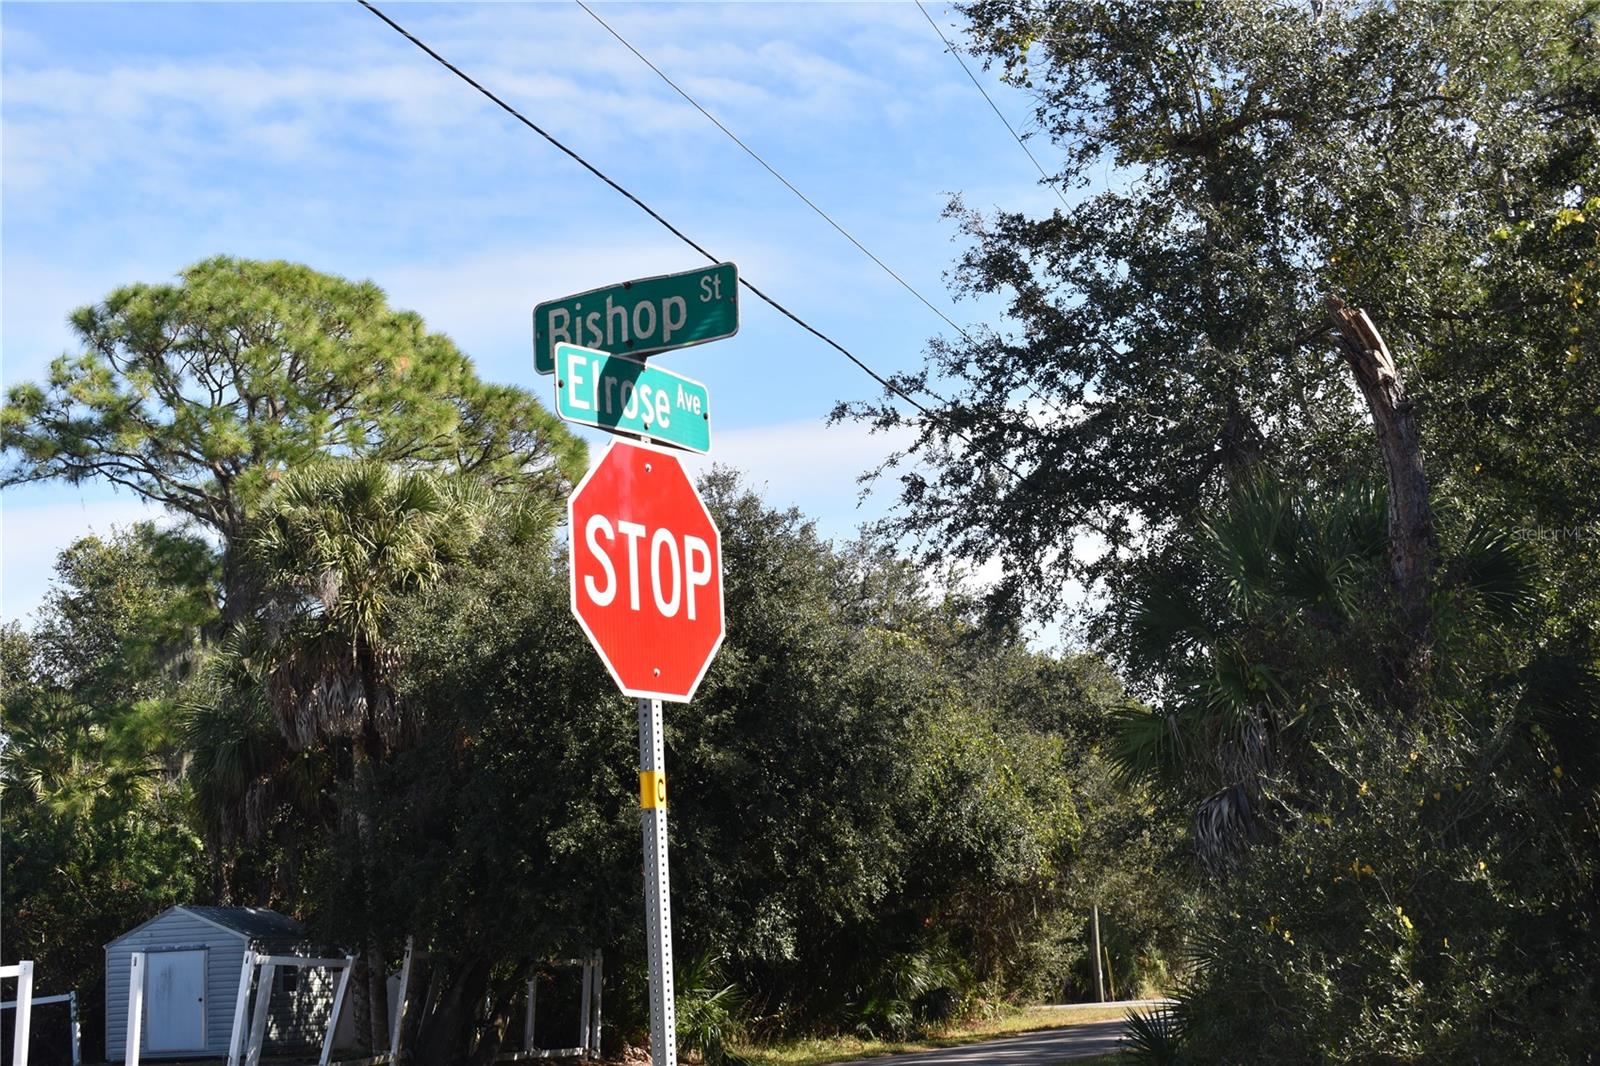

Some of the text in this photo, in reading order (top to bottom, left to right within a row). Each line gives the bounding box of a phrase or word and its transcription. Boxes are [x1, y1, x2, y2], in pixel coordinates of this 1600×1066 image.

[548, 273, 722, 360] Bishop St
[567, 353, 701, 428] Elrose Ave
[584, 513, 712, 621] STOP
